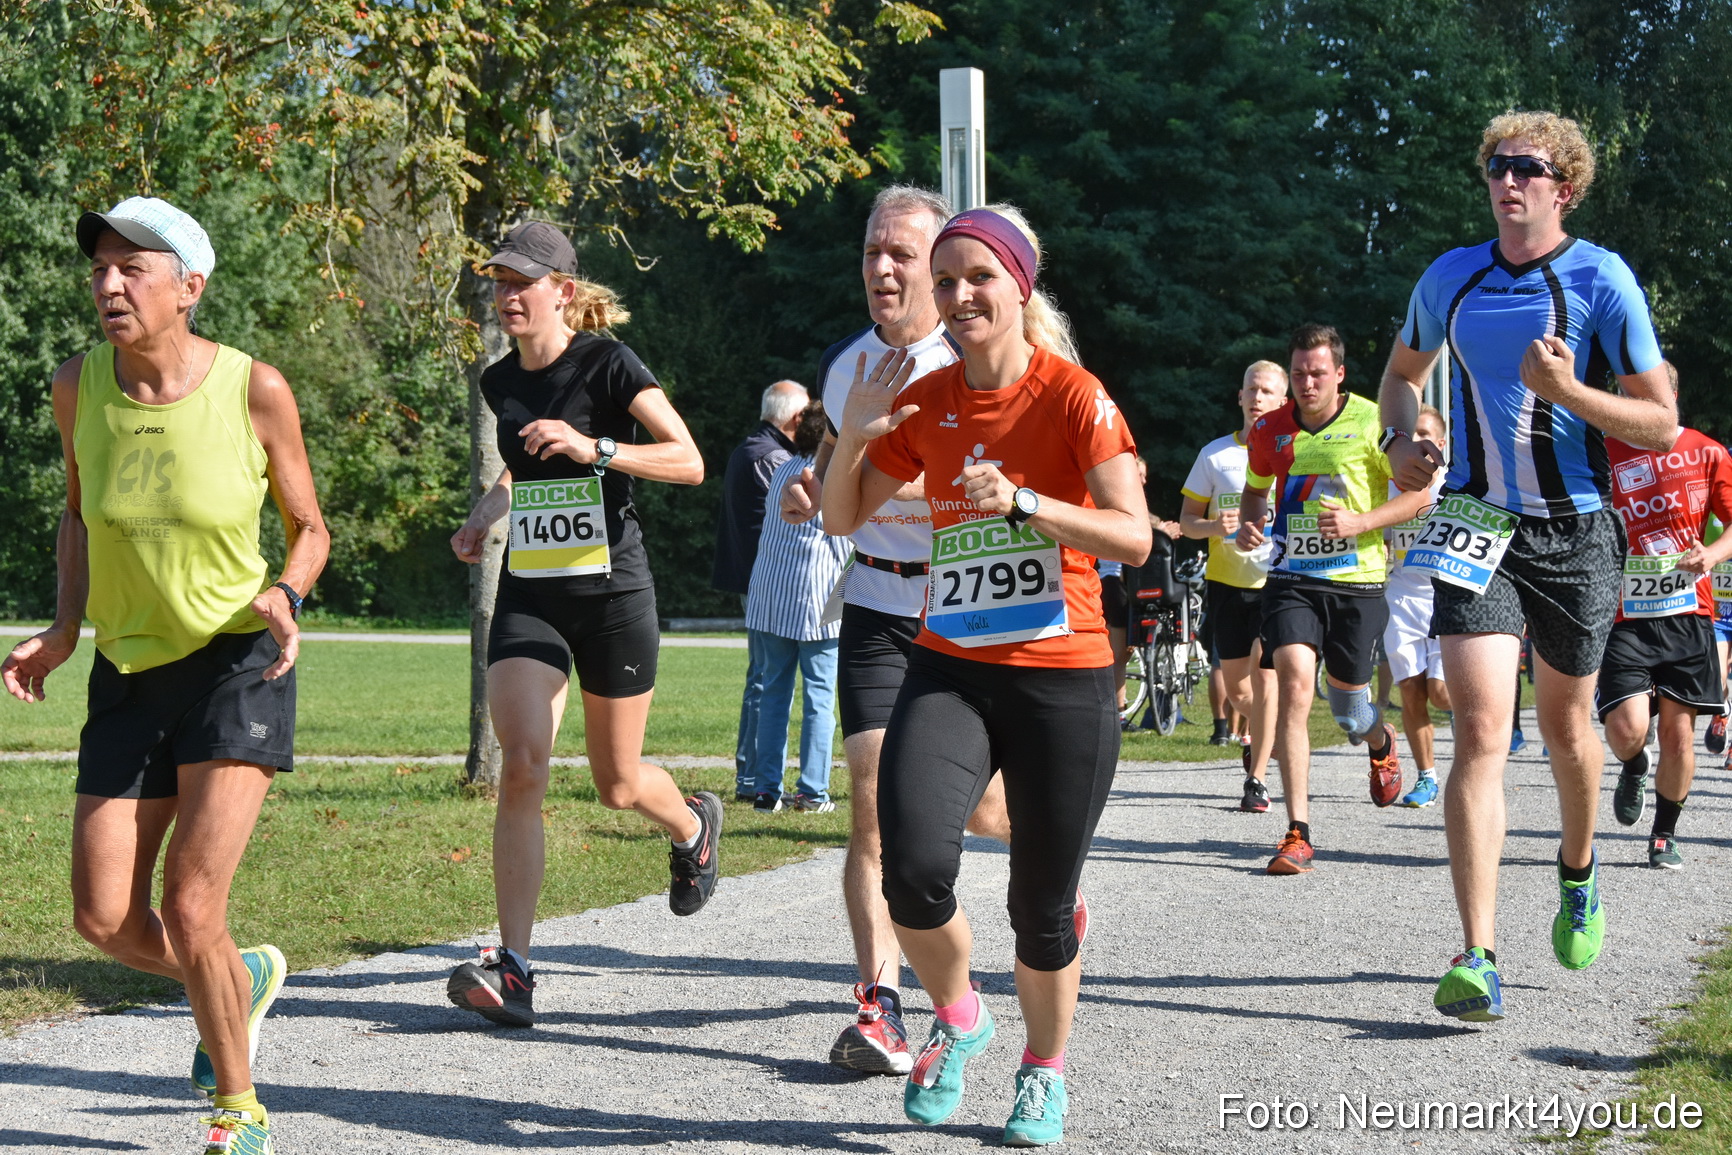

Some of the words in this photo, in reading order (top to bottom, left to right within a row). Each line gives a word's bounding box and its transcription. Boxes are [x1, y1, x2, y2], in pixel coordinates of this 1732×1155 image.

[144, 426, 165, 434] asics
[117, 447, 176, 494] CIS
[1616, 458, 1649, 473] raumbox
[1661, 468, 1699, 482] schenken
[515, 482, 591, 507] BOCK
[115, 517, 182, 527] INTERSPORT
[518, 512, 594, 544] 1406
[121, 528, 170, 539] LANGE
[937, 522, 1046, 561] BOCK
[1417, 521, 1492, 561] 2303
[1293, 536, 1349, 555] 2683
[1300, 559, 1350, 570] DOMINIK
[1411, 552, 1473, 578] MARKUS
[942, 558, 1046, 607] 2799
[1630, 574, 1687, 597] 2264
[1634, 597, 1686, 611] RAIMUND
[962, 614, 990, 632] Walli
